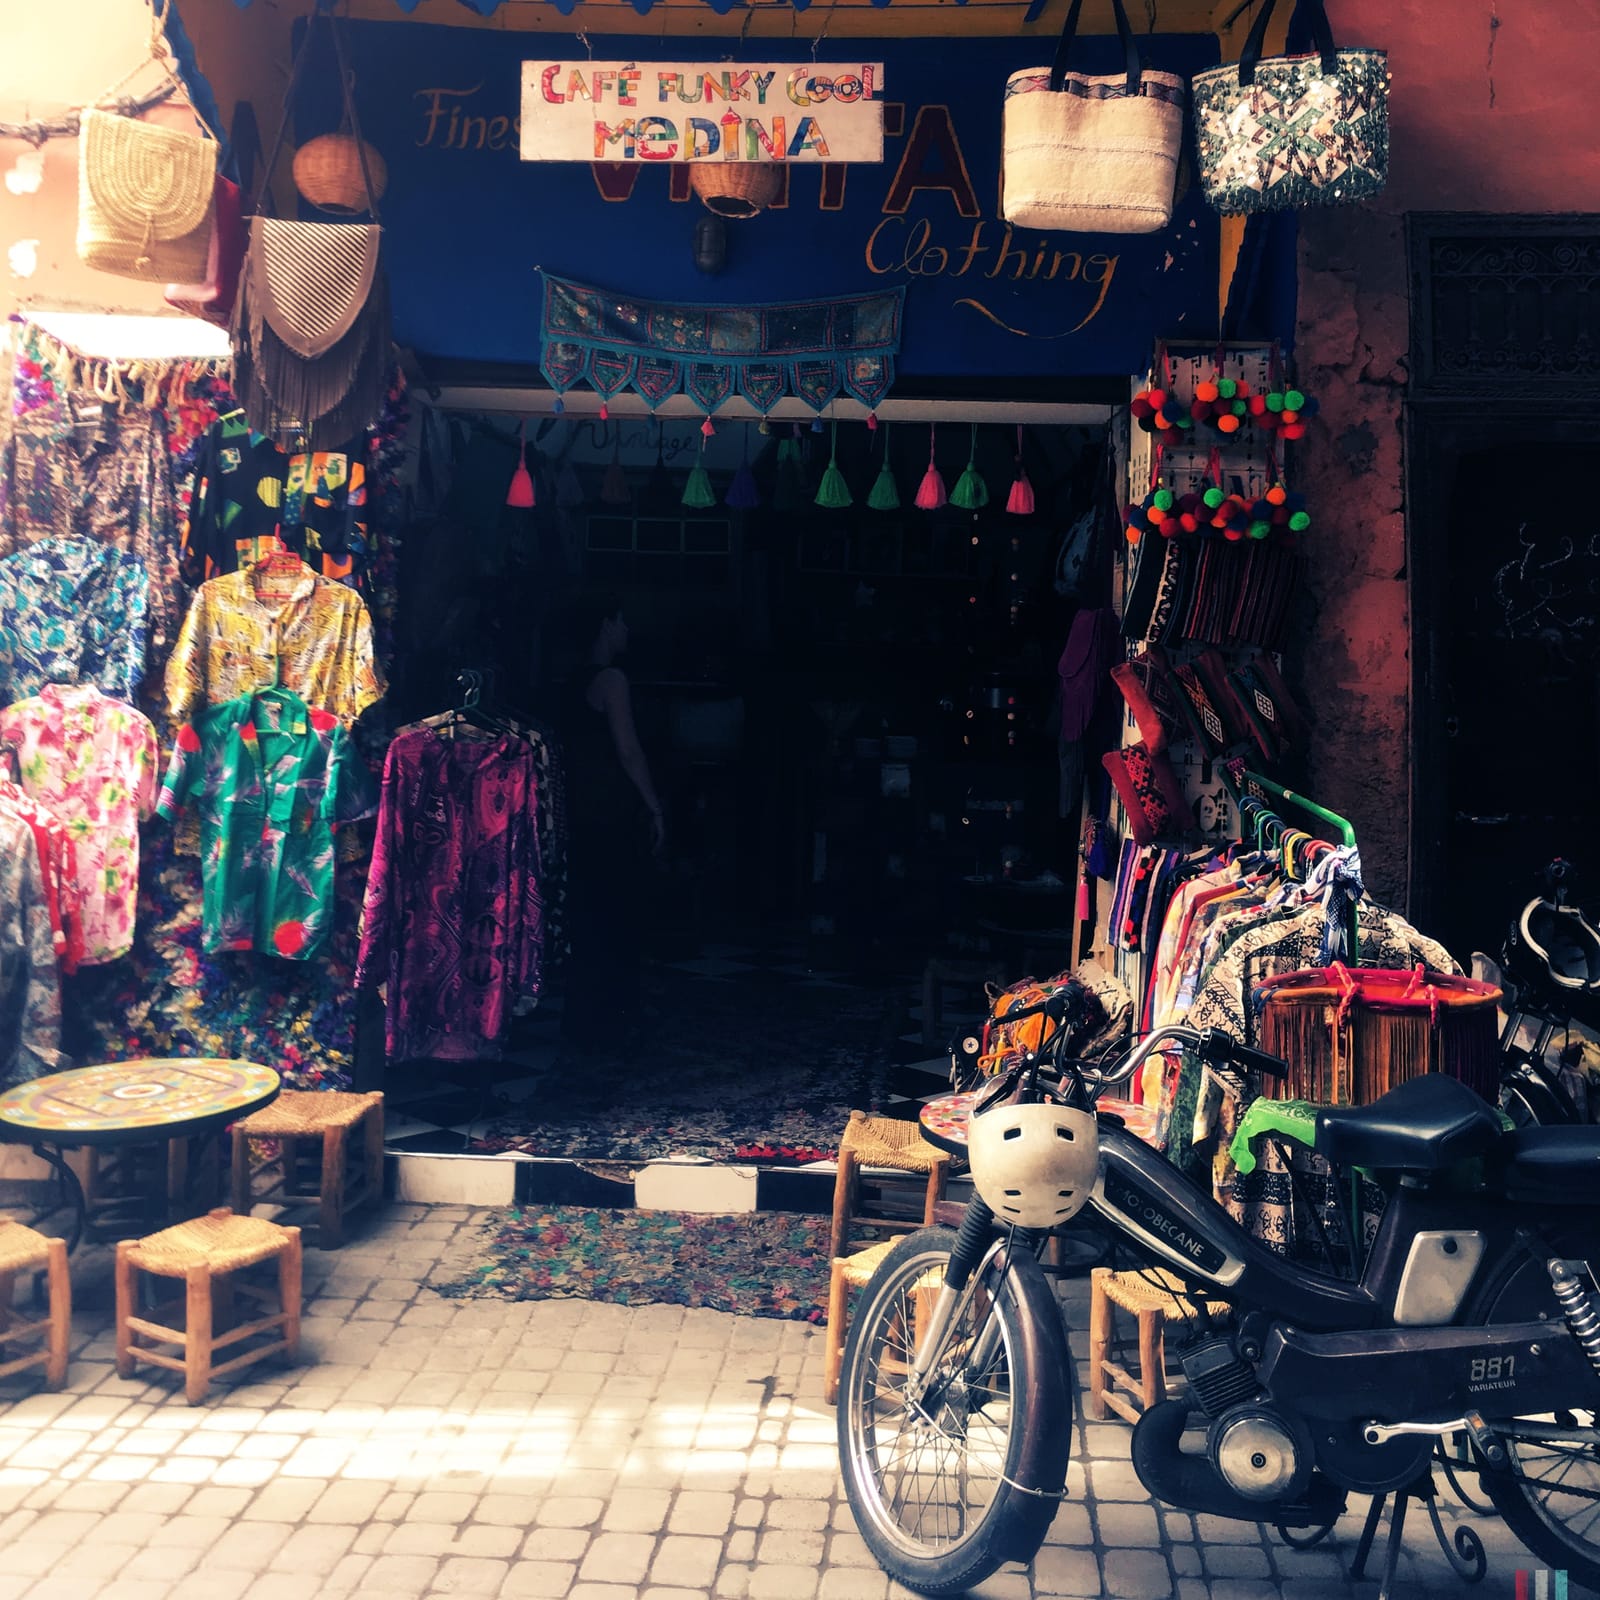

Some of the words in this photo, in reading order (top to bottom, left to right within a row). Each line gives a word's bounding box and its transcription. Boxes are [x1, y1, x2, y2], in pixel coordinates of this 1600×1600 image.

[541, 63, 641, 106] CAFÉ
[658, 70, 776, 104] FUNKY
[865, 215, 1119, 338] Clothing
[1468, 1379, 1516, 1393] VARIATEUR
[1470, 1355, 1515, 1382] 881
